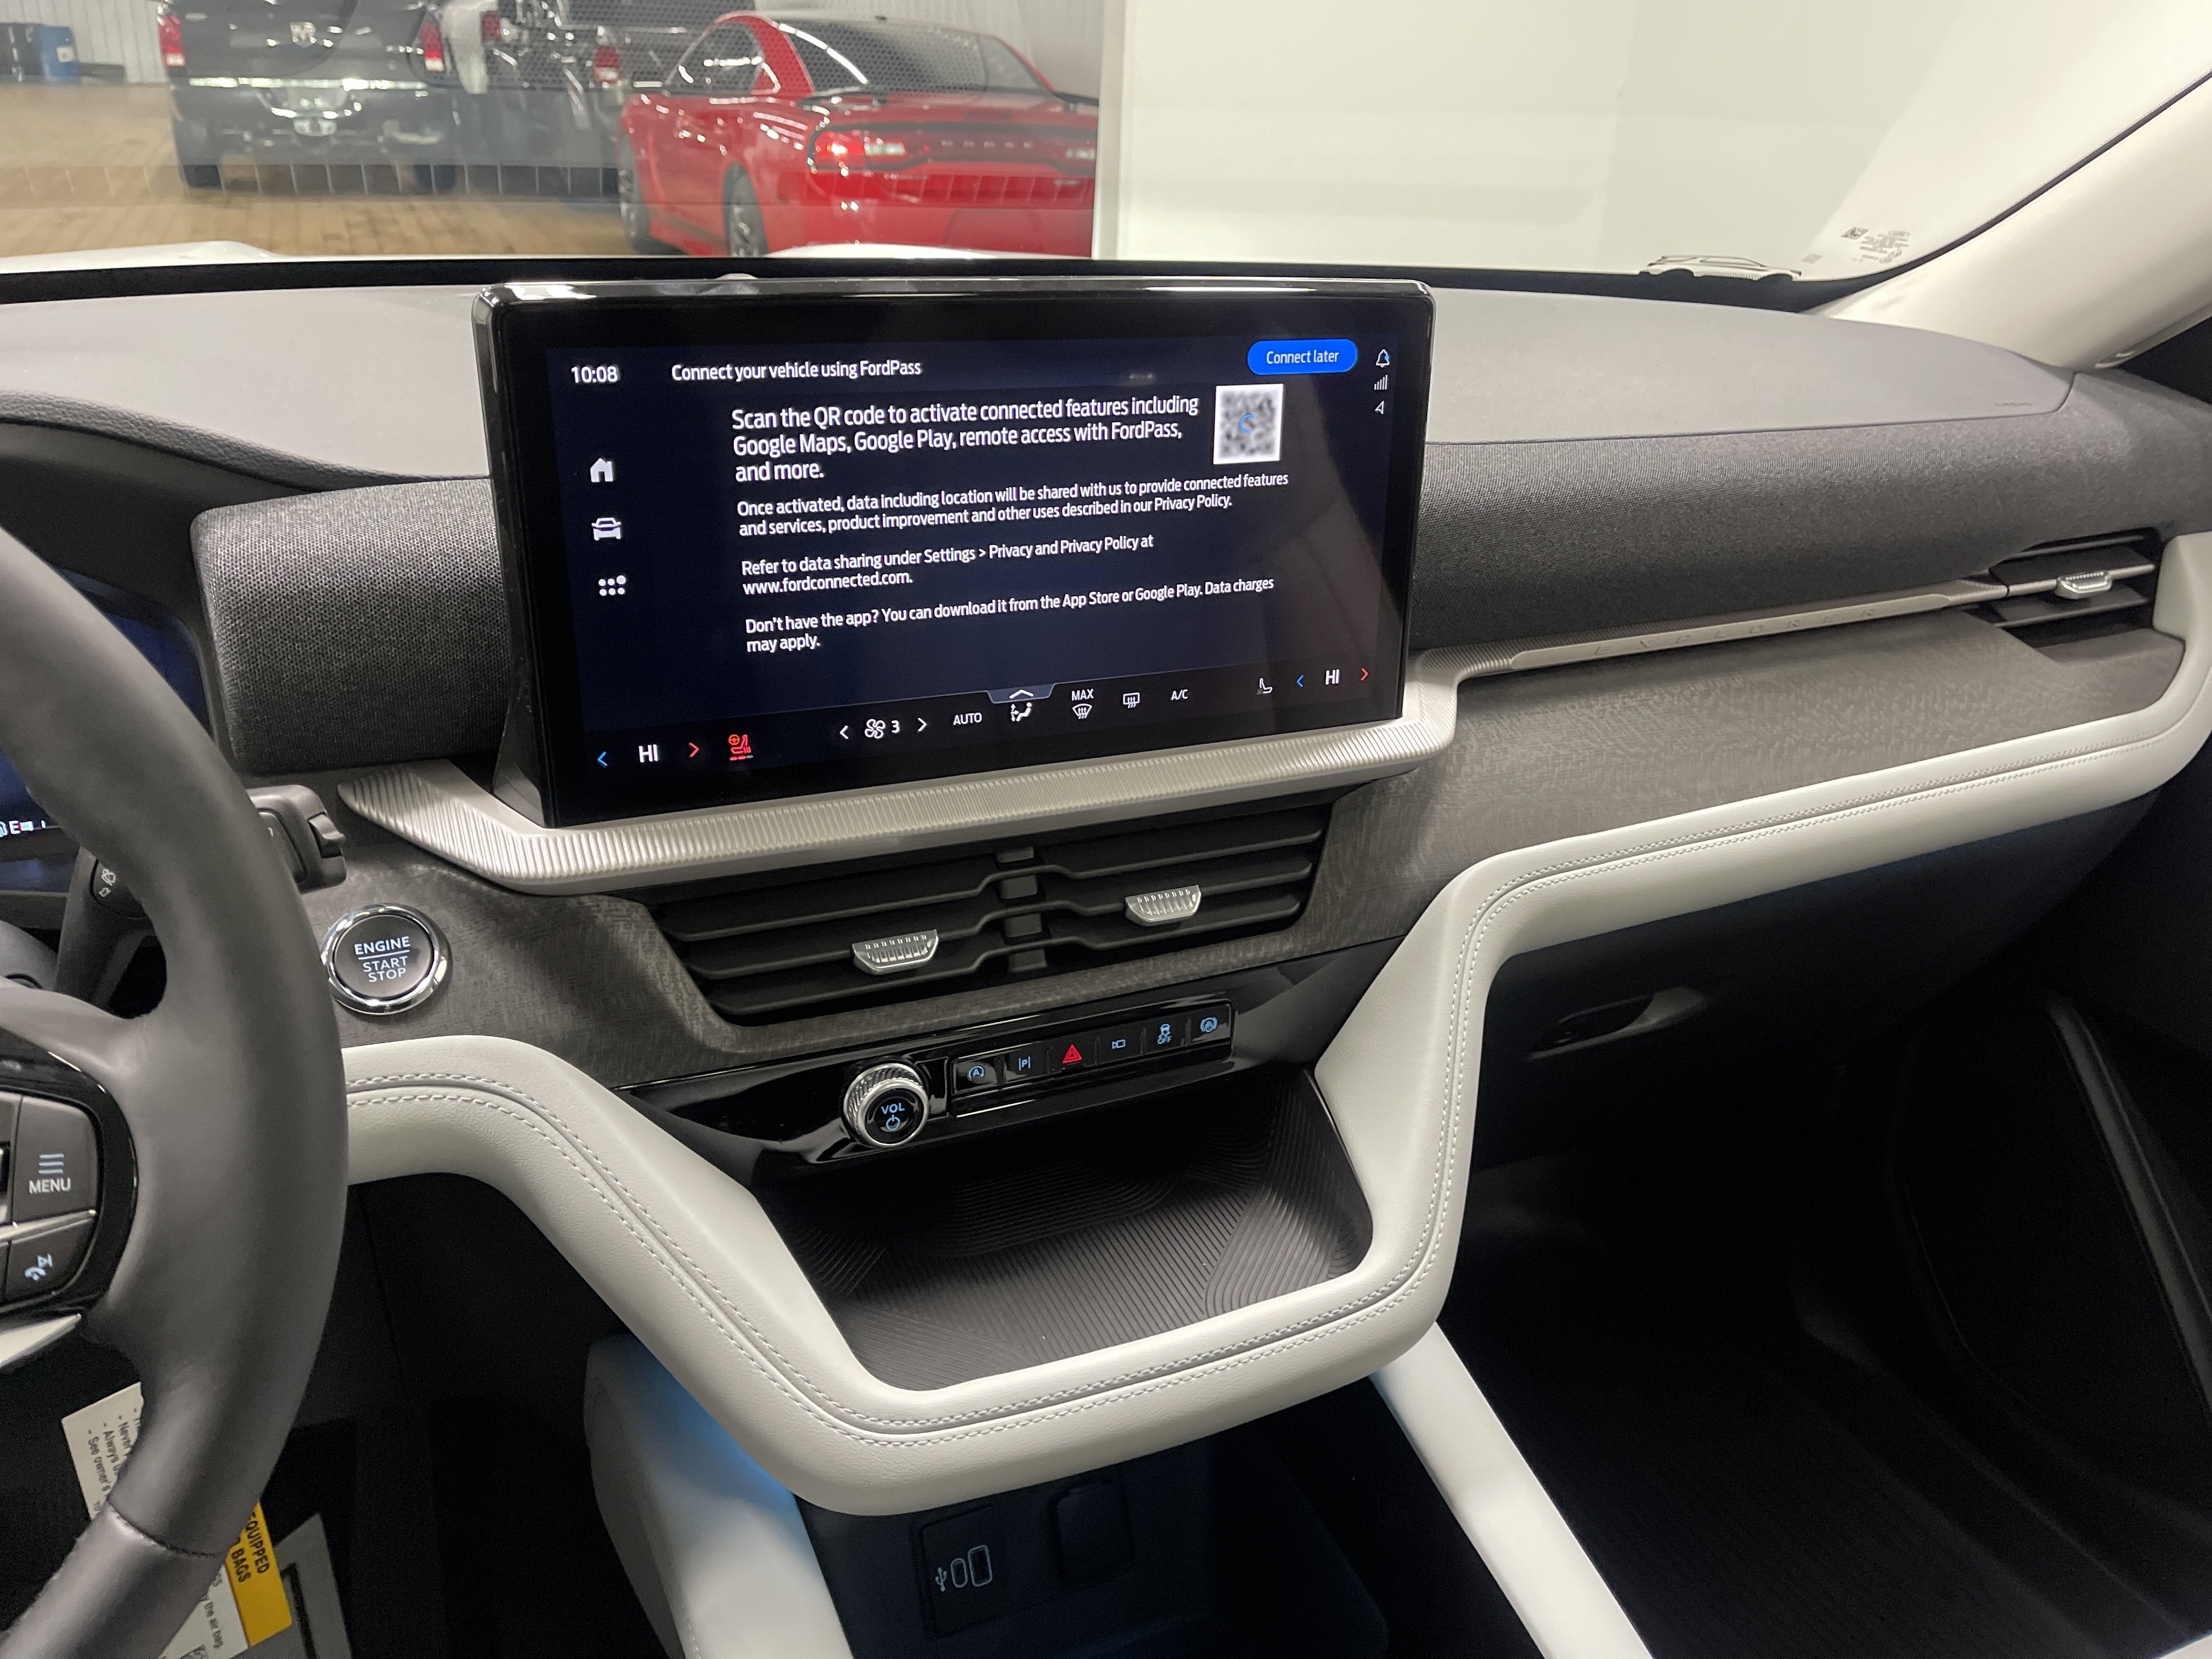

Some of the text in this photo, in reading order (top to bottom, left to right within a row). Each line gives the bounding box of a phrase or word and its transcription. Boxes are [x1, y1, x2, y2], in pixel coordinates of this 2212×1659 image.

[1266, 349, 1340, 364] Connect later
[571, 365, 619, 383] 10:08
[672, 359, 922, 382] Connect your vehicle using FordPass
[732, 395, 1199, 430] Scan the QR code to activate connected features including
[733, 420, 1182, 458] Google Maps, Google Play, remote access with FordPass,
[735, 461, 825, 482] and more.
[737, 473, 1289, 516] Once activated, data including location will be shared with us to provide connected features
[739, 493, 1232, 537] and services, product improvement and other uses described in our Privacy Policy.
[741, 559, 780, 575] Refer
[781, 558, 797, 573] to
[799, 556, 832, 572] data
[834, 553, 883, 569] sharing
[884, 550, 922, 566] under
[923, 547, 976, 563] Settings
[989, 544, 1034, 559] Privacy
[1035, 540, 1058, 556] and
[1060, 539, 1103, 554] Privacy
[1104, 535, 1139, 551] Policy
[1140, 534, 1154, 548] at
[742, 571, 913, 595] www.fordconnected.com.
[746, 578, 1274, 634] Don't have the app? You can download it from the App Store or Google Play. Data charges
[747, 633, 821, 653] may apply.
[1325, 668, 1340, 685] HI
[1071, 688, 1094, 701] MAX
[1171, 689, 1189, 701] A/C
[891, 720, 900, 733] 3
[953, 712, 983, 726] AUTO
[638, 744, 658, 763] HI
[353, 935, 411, 956] ENGINE
[362, 956, 408, 973] START
[368, 967, 407, 983] STOP
[881, 1102, 905, 1114] VOL
[29, 1177, 71, 1194] MENU
[88, 1436, 99, 1455] See
[103, 1430, 119, 1463] Always
[231, 1547, 252, 1583] BAGS
